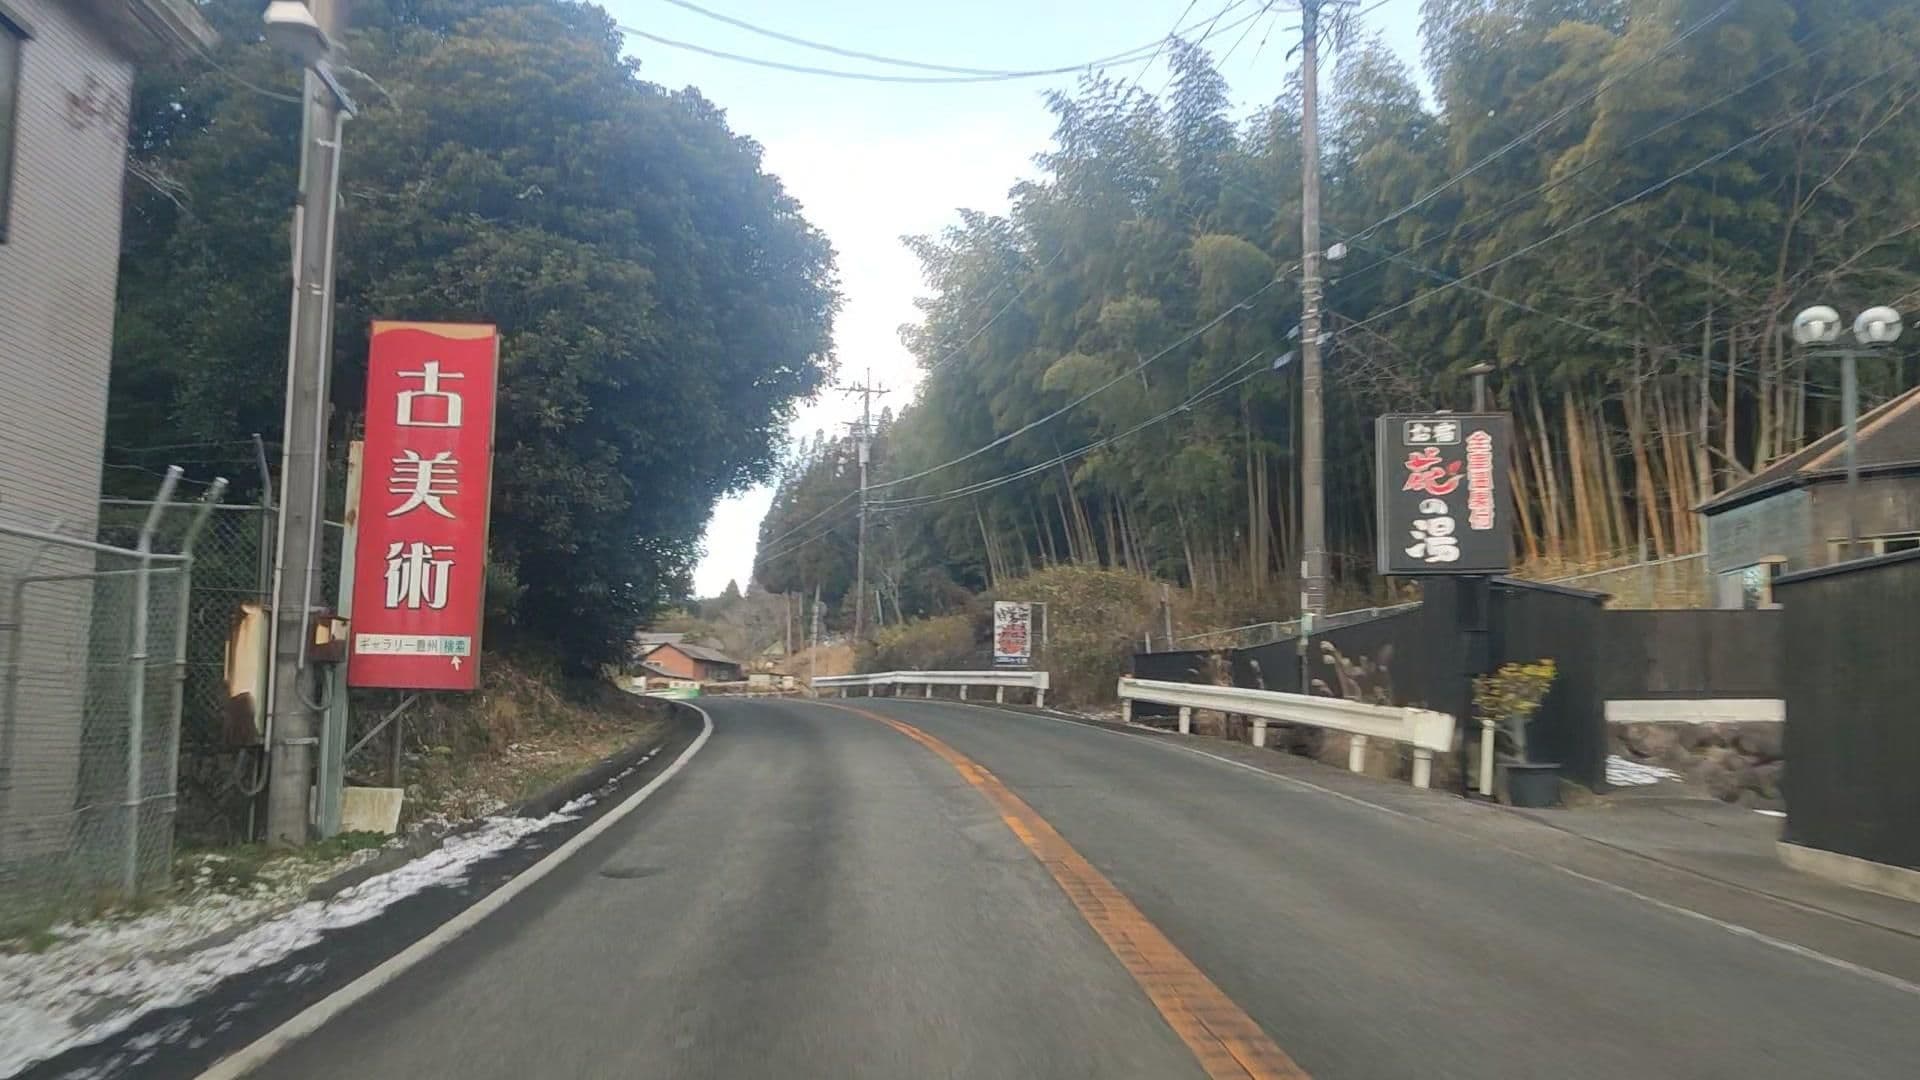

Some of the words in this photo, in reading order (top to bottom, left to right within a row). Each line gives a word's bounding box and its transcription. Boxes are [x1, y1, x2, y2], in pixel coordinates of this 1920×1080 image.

[384, 359, 465, 609] 古美術
[1402, 446, 1466, 563] 花の湯
